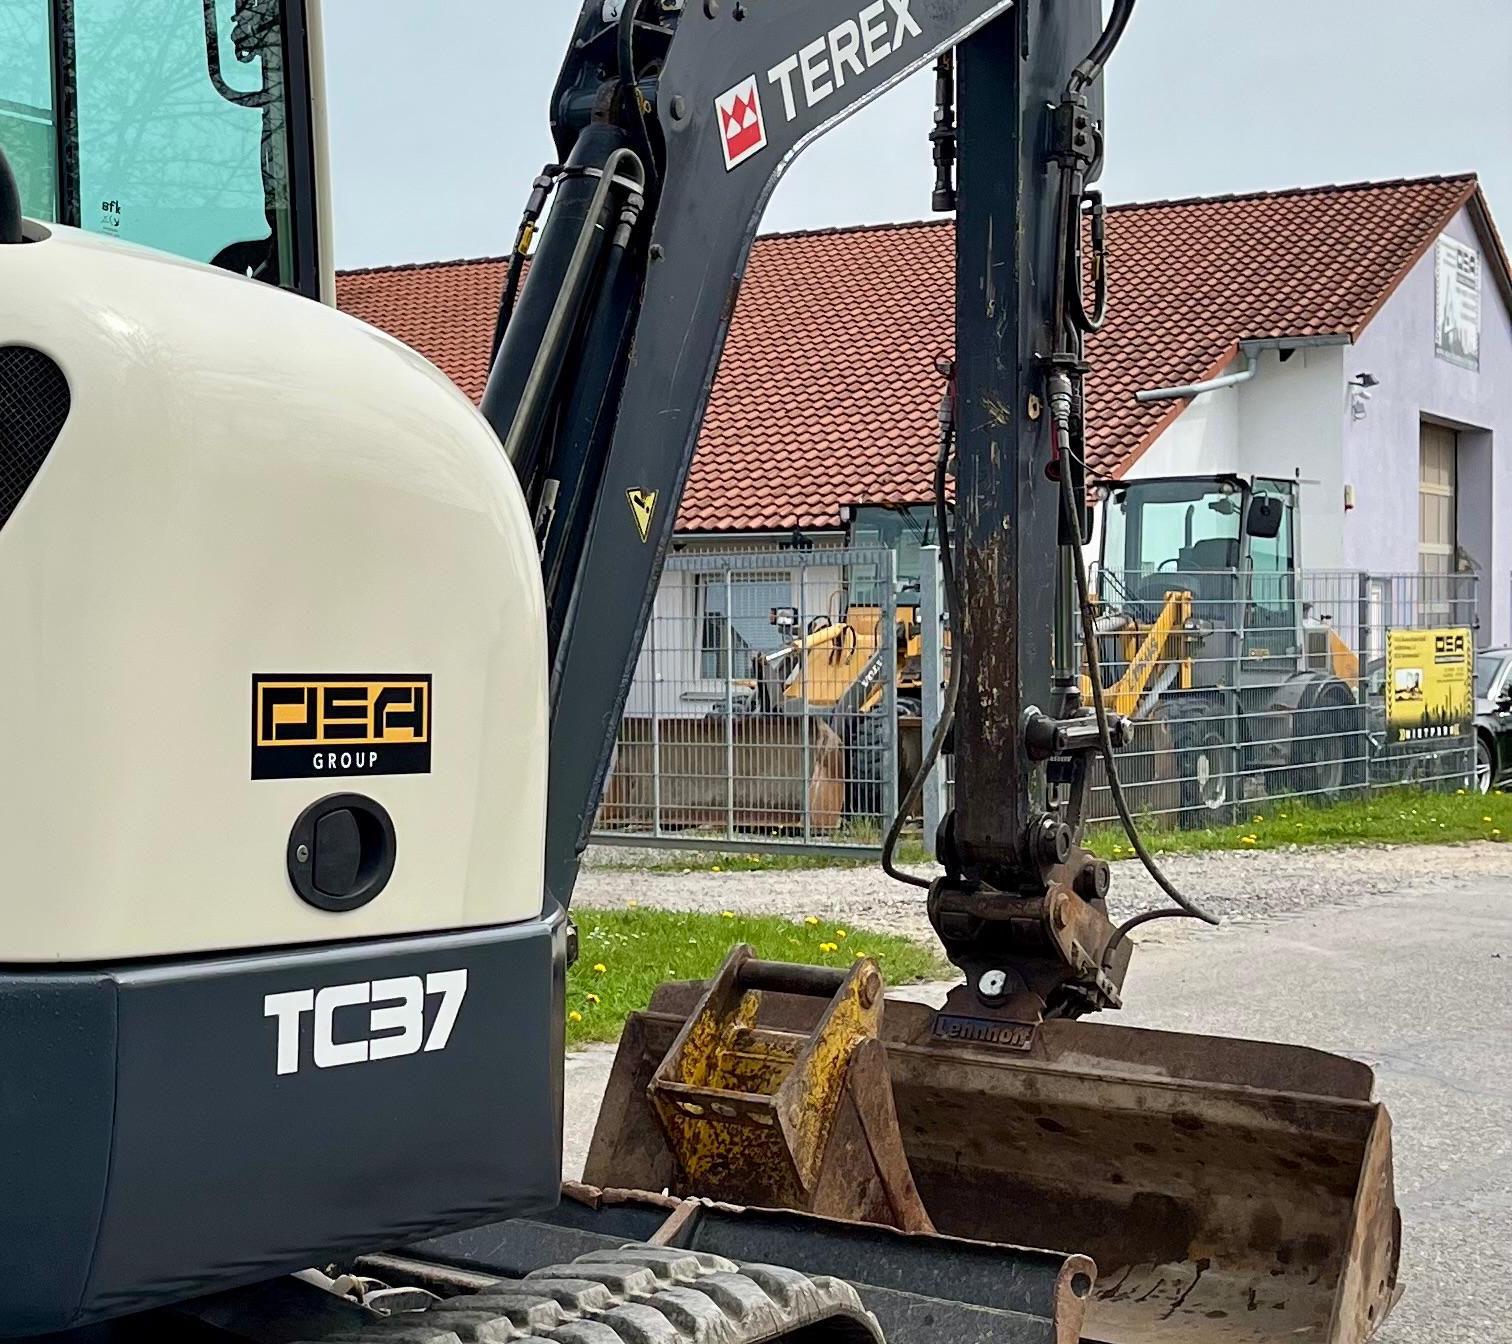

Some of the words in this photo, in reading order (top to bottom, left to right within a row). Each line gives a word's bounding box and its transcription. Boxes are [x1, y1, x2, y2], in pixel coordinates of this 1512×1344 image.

[861, 657, 883, 687] VOLV
[312, 751, 378, 770] GROUP
[264, 969, 468, 1075] TC37
